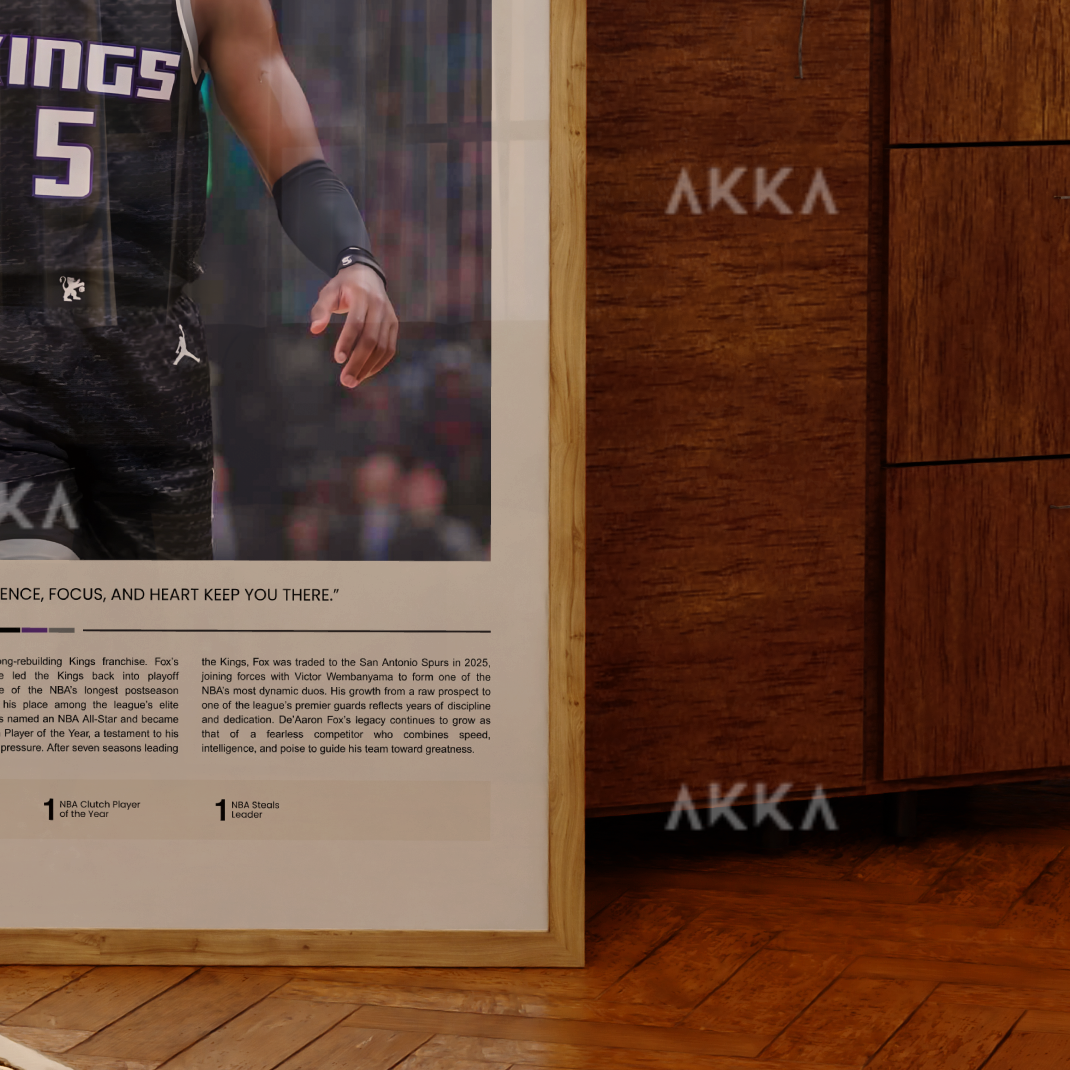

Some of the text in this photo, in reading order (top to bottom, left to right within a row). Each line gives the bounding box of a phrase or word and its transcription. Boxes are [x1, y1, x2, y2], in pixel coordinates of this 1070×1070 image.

[32, 106, 96, 198] 5
[49, 587, 106, 602] FOCUS,
[110, 587, 144, 600] AND
[150, 587, 199, 600] HEART
[204, 588, 239, 601] KEEP
[244, 588, 277, 601] YOU
[43, 798, 53, 820] 1
[59, 800, 140, 811] NBA Clutch Player
[215, 798, 225, 821] 1
[231, 801, 279, 811] NBA Steals
[59, 809, 68, 817] of
[70, 809, 86, 817] the
[231, 810, 262, 818] Leader
